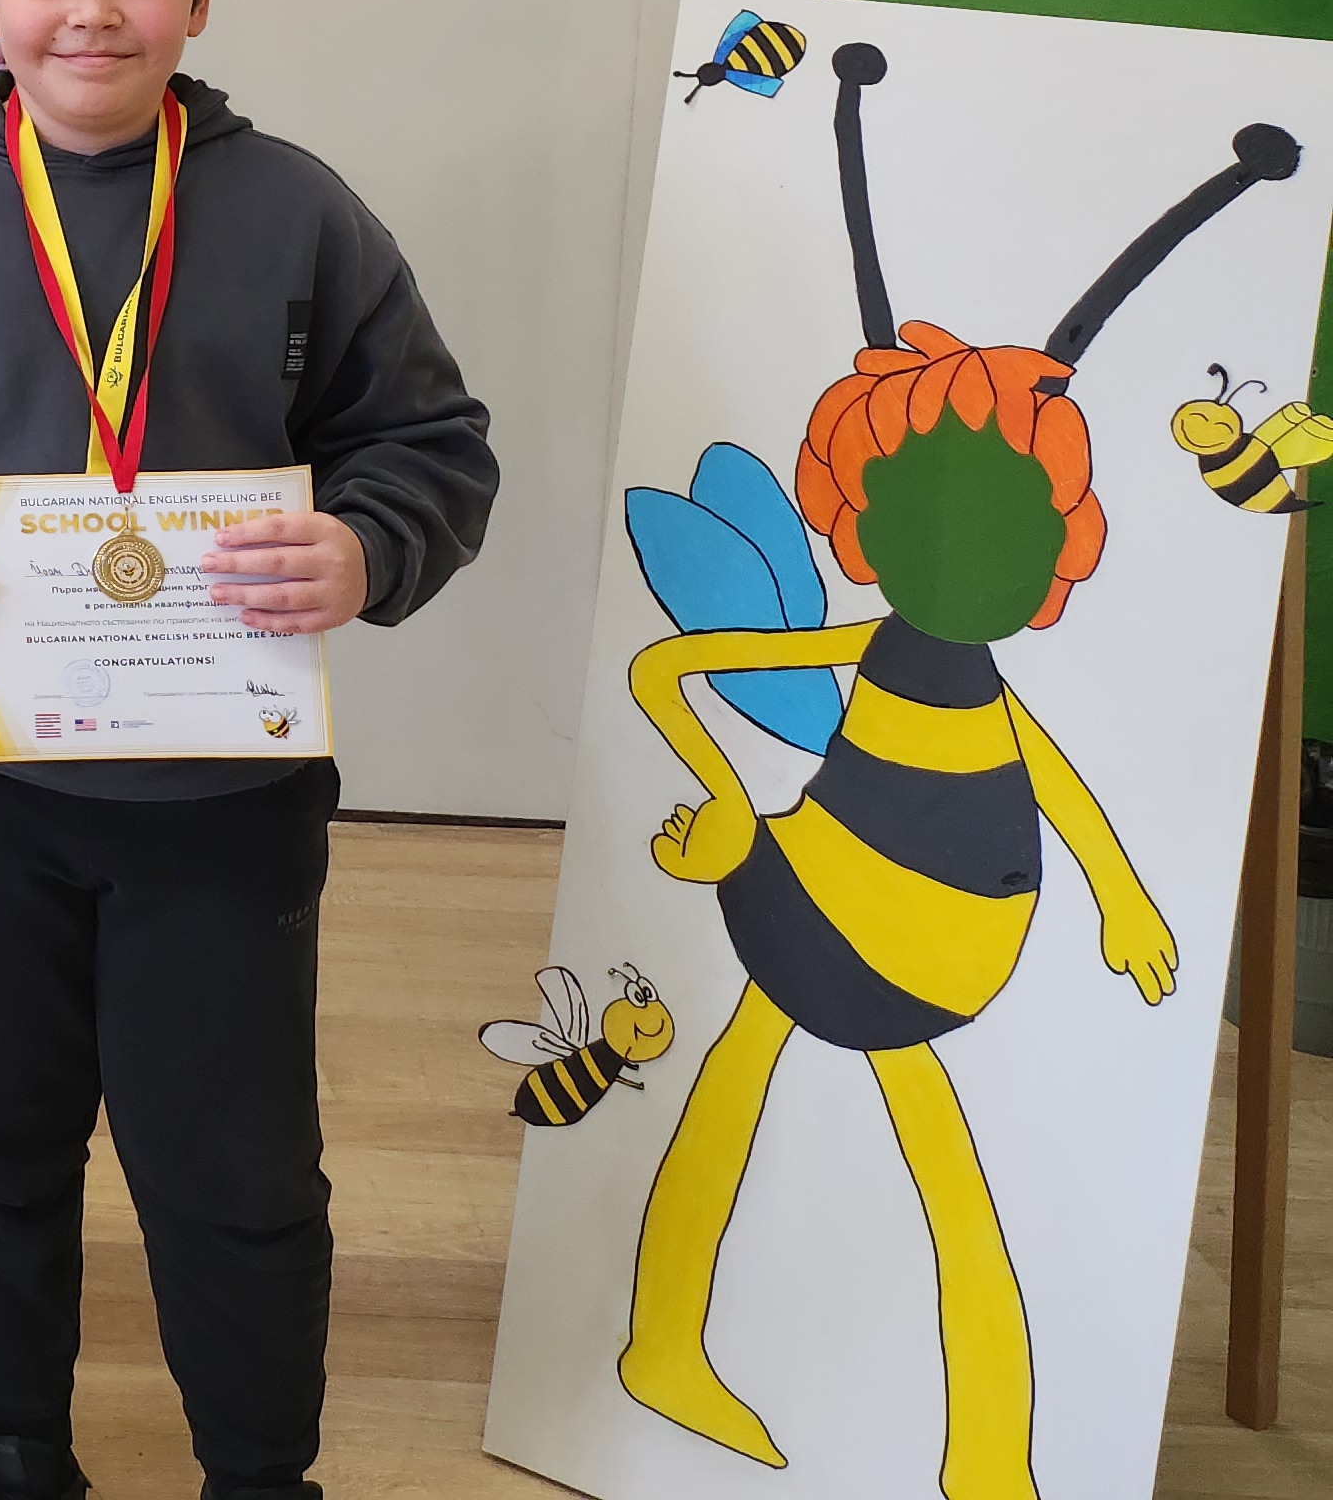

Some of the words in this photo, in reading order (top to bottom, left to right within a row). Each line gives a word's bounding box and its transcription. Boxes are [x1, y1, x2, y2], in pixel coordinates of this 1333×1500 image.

[114, 299, 133, 363] BULGARIAN
[20, 497, 85, 507] BULGARIAN
[89, 495, 146, 506] NATIONAL
[149, 494, 198, 505] ENGLISH
[201, 493, 257, 504] SPELLING
[260, 492, 282, 502] BEE
[20, 512, 147, 535] SCHOOL
[51, 586, 83, 595] Първо
[26, 635, 86, 644] BULGARIAN
[89, 634, 142, 643] NATIONAL
[145, 633, 189, 642] ENGLISH
[192, 631, 243, 641] SPELLING
[246, 630, 267, 639] BEE
[94, 656, 215, 668] CONGRATULATIONS!
